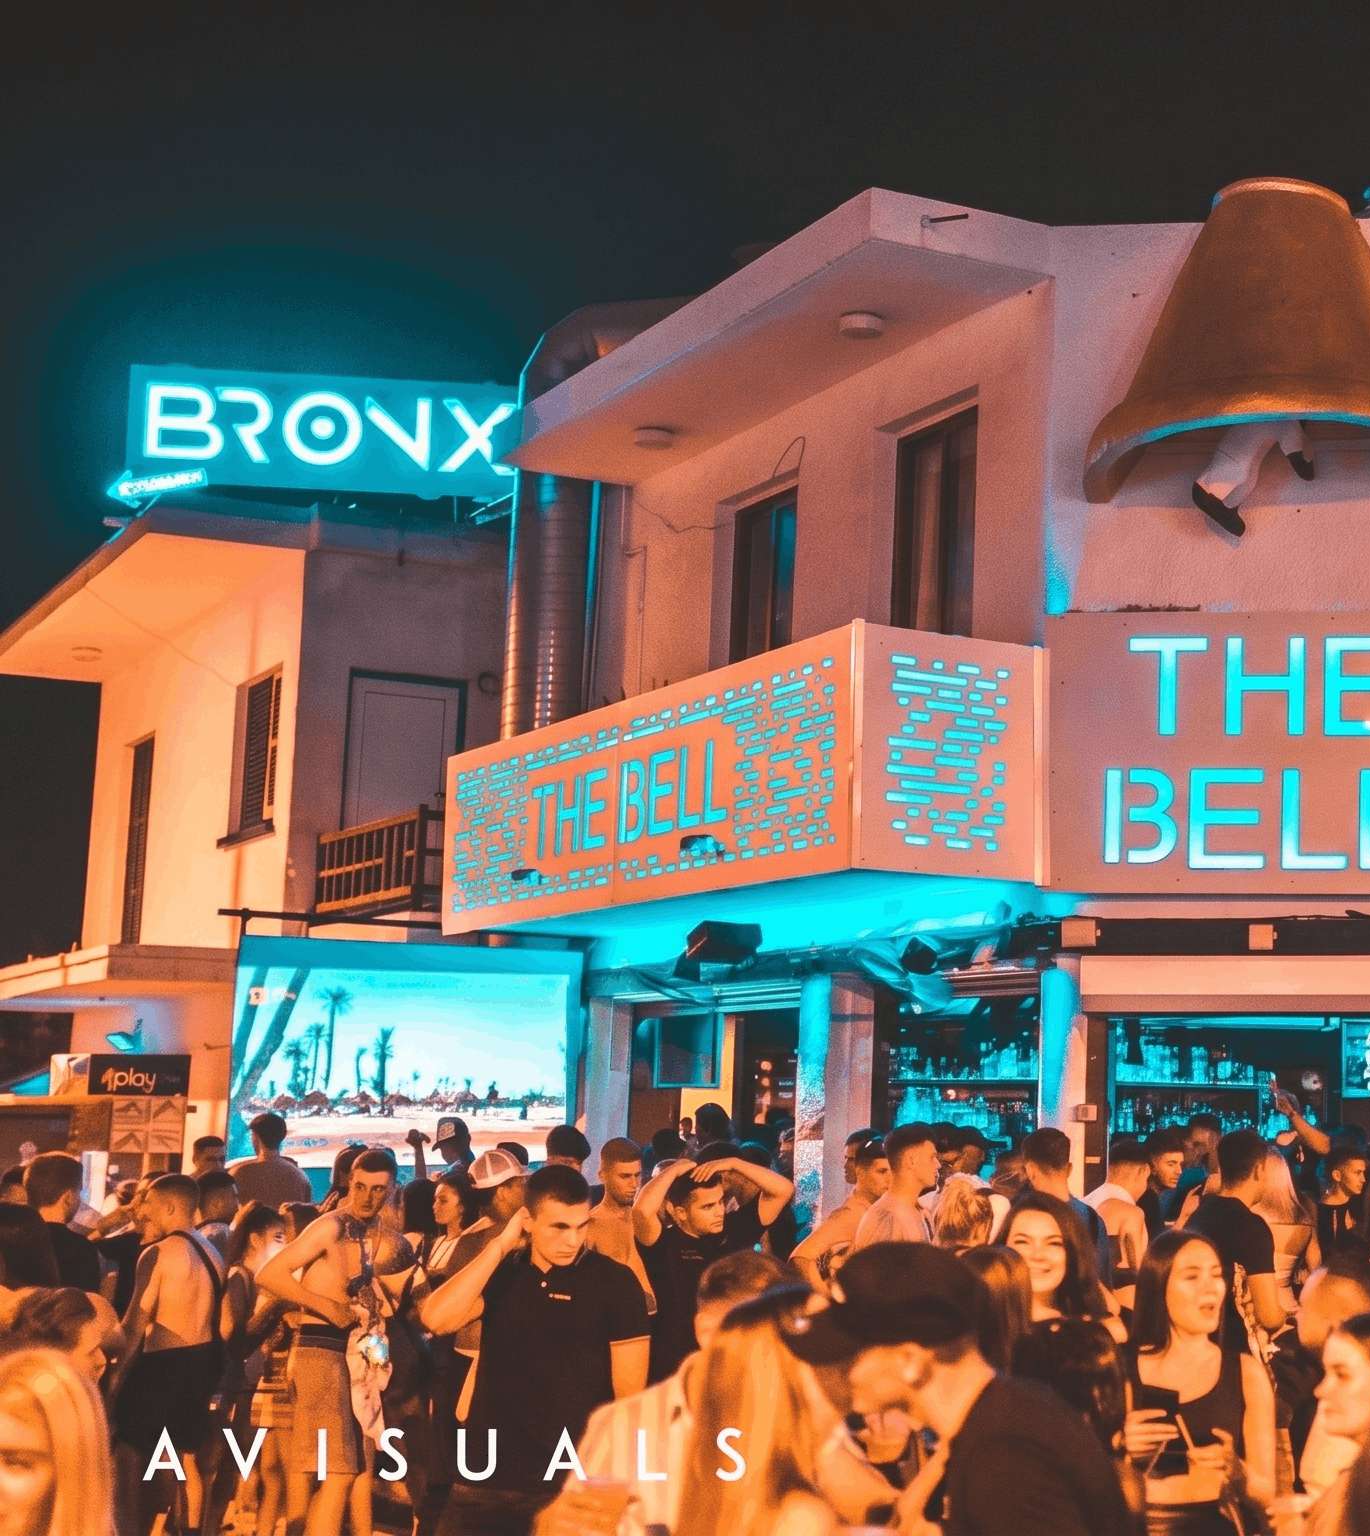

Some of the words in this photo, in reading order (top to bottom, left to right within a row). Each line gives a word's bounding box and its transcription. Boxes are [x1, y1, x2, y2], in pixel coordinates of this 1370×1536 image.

[143, 382, 518, 476] BRONX
[531, 767, 609, 860] THE
[617, 738, 729, 845] BELL
